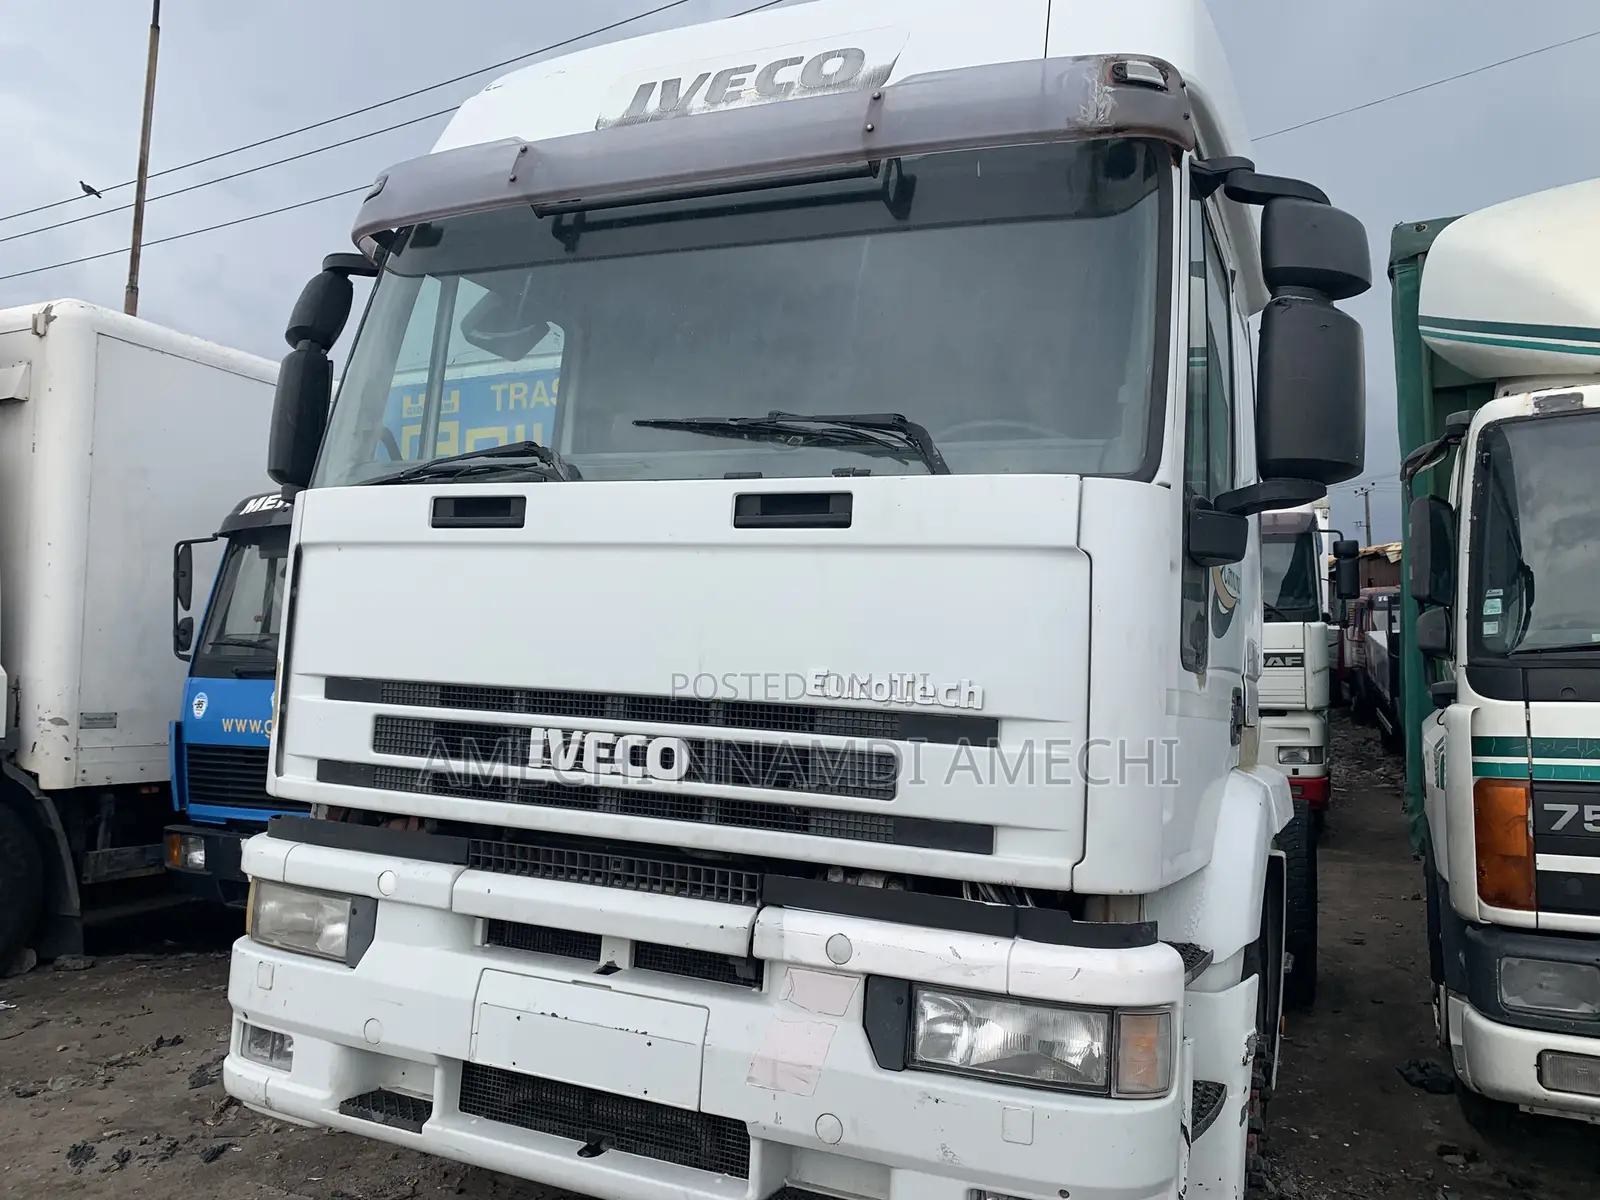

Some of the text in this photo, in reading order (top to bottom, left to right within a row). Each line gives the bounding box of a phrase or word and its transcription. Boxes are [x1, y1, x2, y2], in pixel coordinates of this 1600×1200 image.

[624, 47, 865, 118] IVECO
[1264, 656, 1303, 667] AF
[806, 667, 985, 710] EuroTech
[528, 727, 689, 780] IVECO
